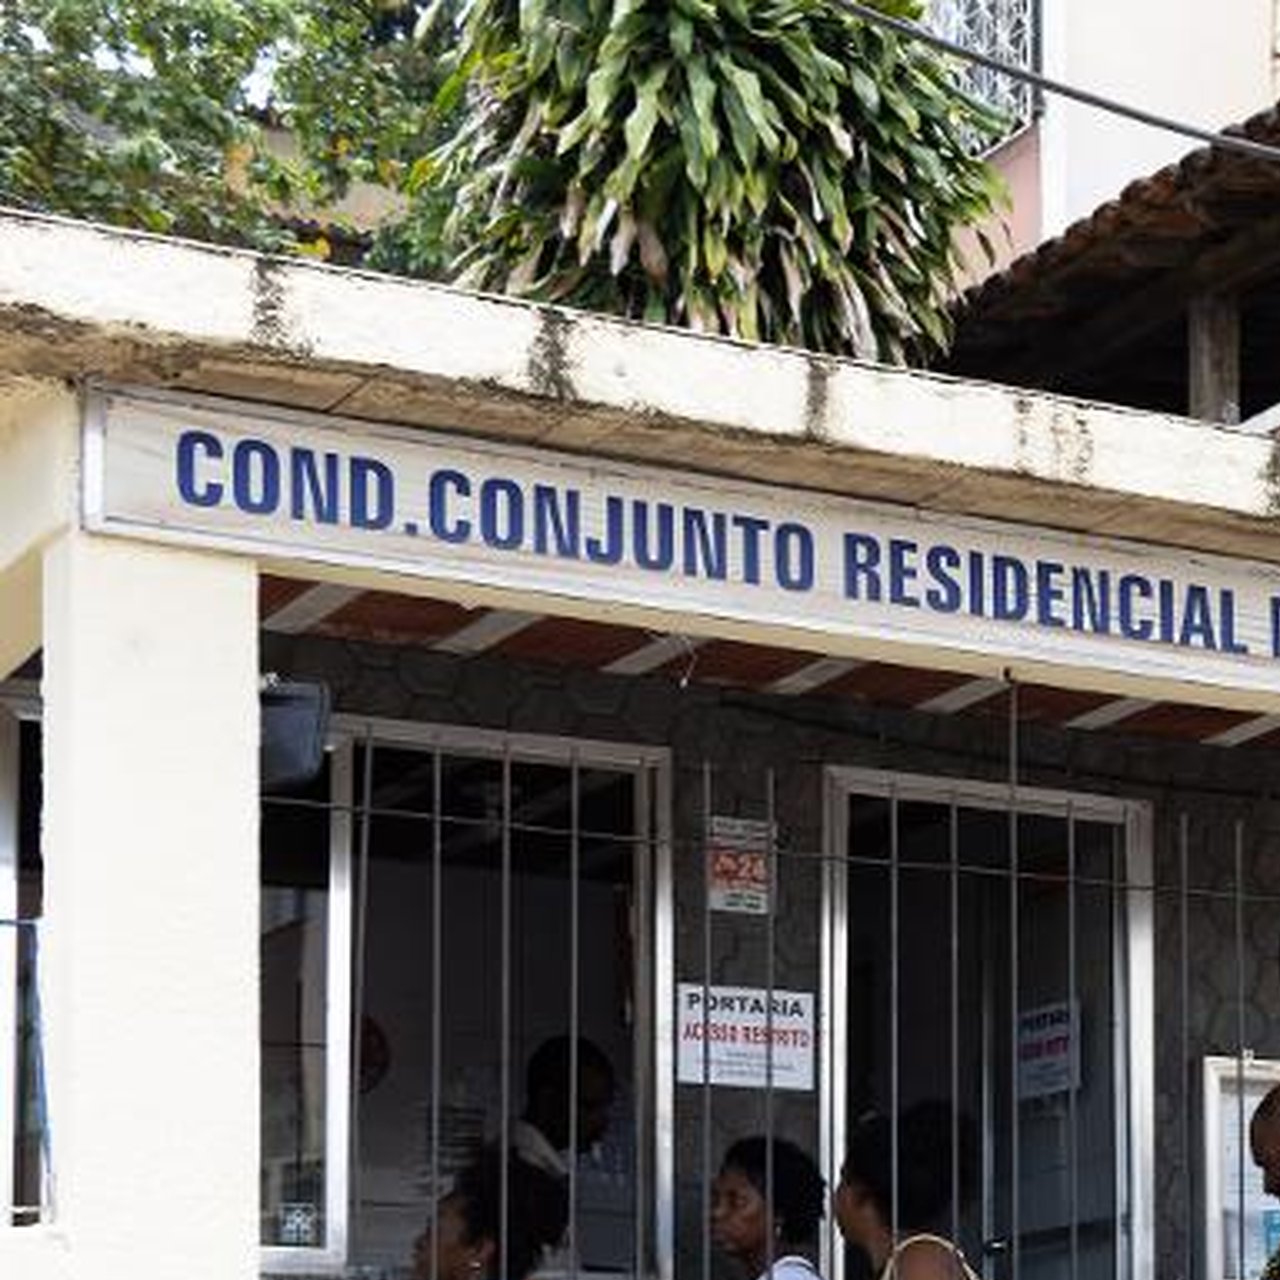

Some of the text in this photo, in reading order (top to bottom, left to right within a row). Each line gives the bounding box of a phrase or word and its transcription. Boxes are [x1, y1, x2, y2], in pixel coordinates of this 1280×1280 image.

[175, 428, 815, 593] COND.CONJUNTO
[843, 530, 1248, 656] RESIDENCIAL
[687, 992, 804, 1018] PORTARIA
